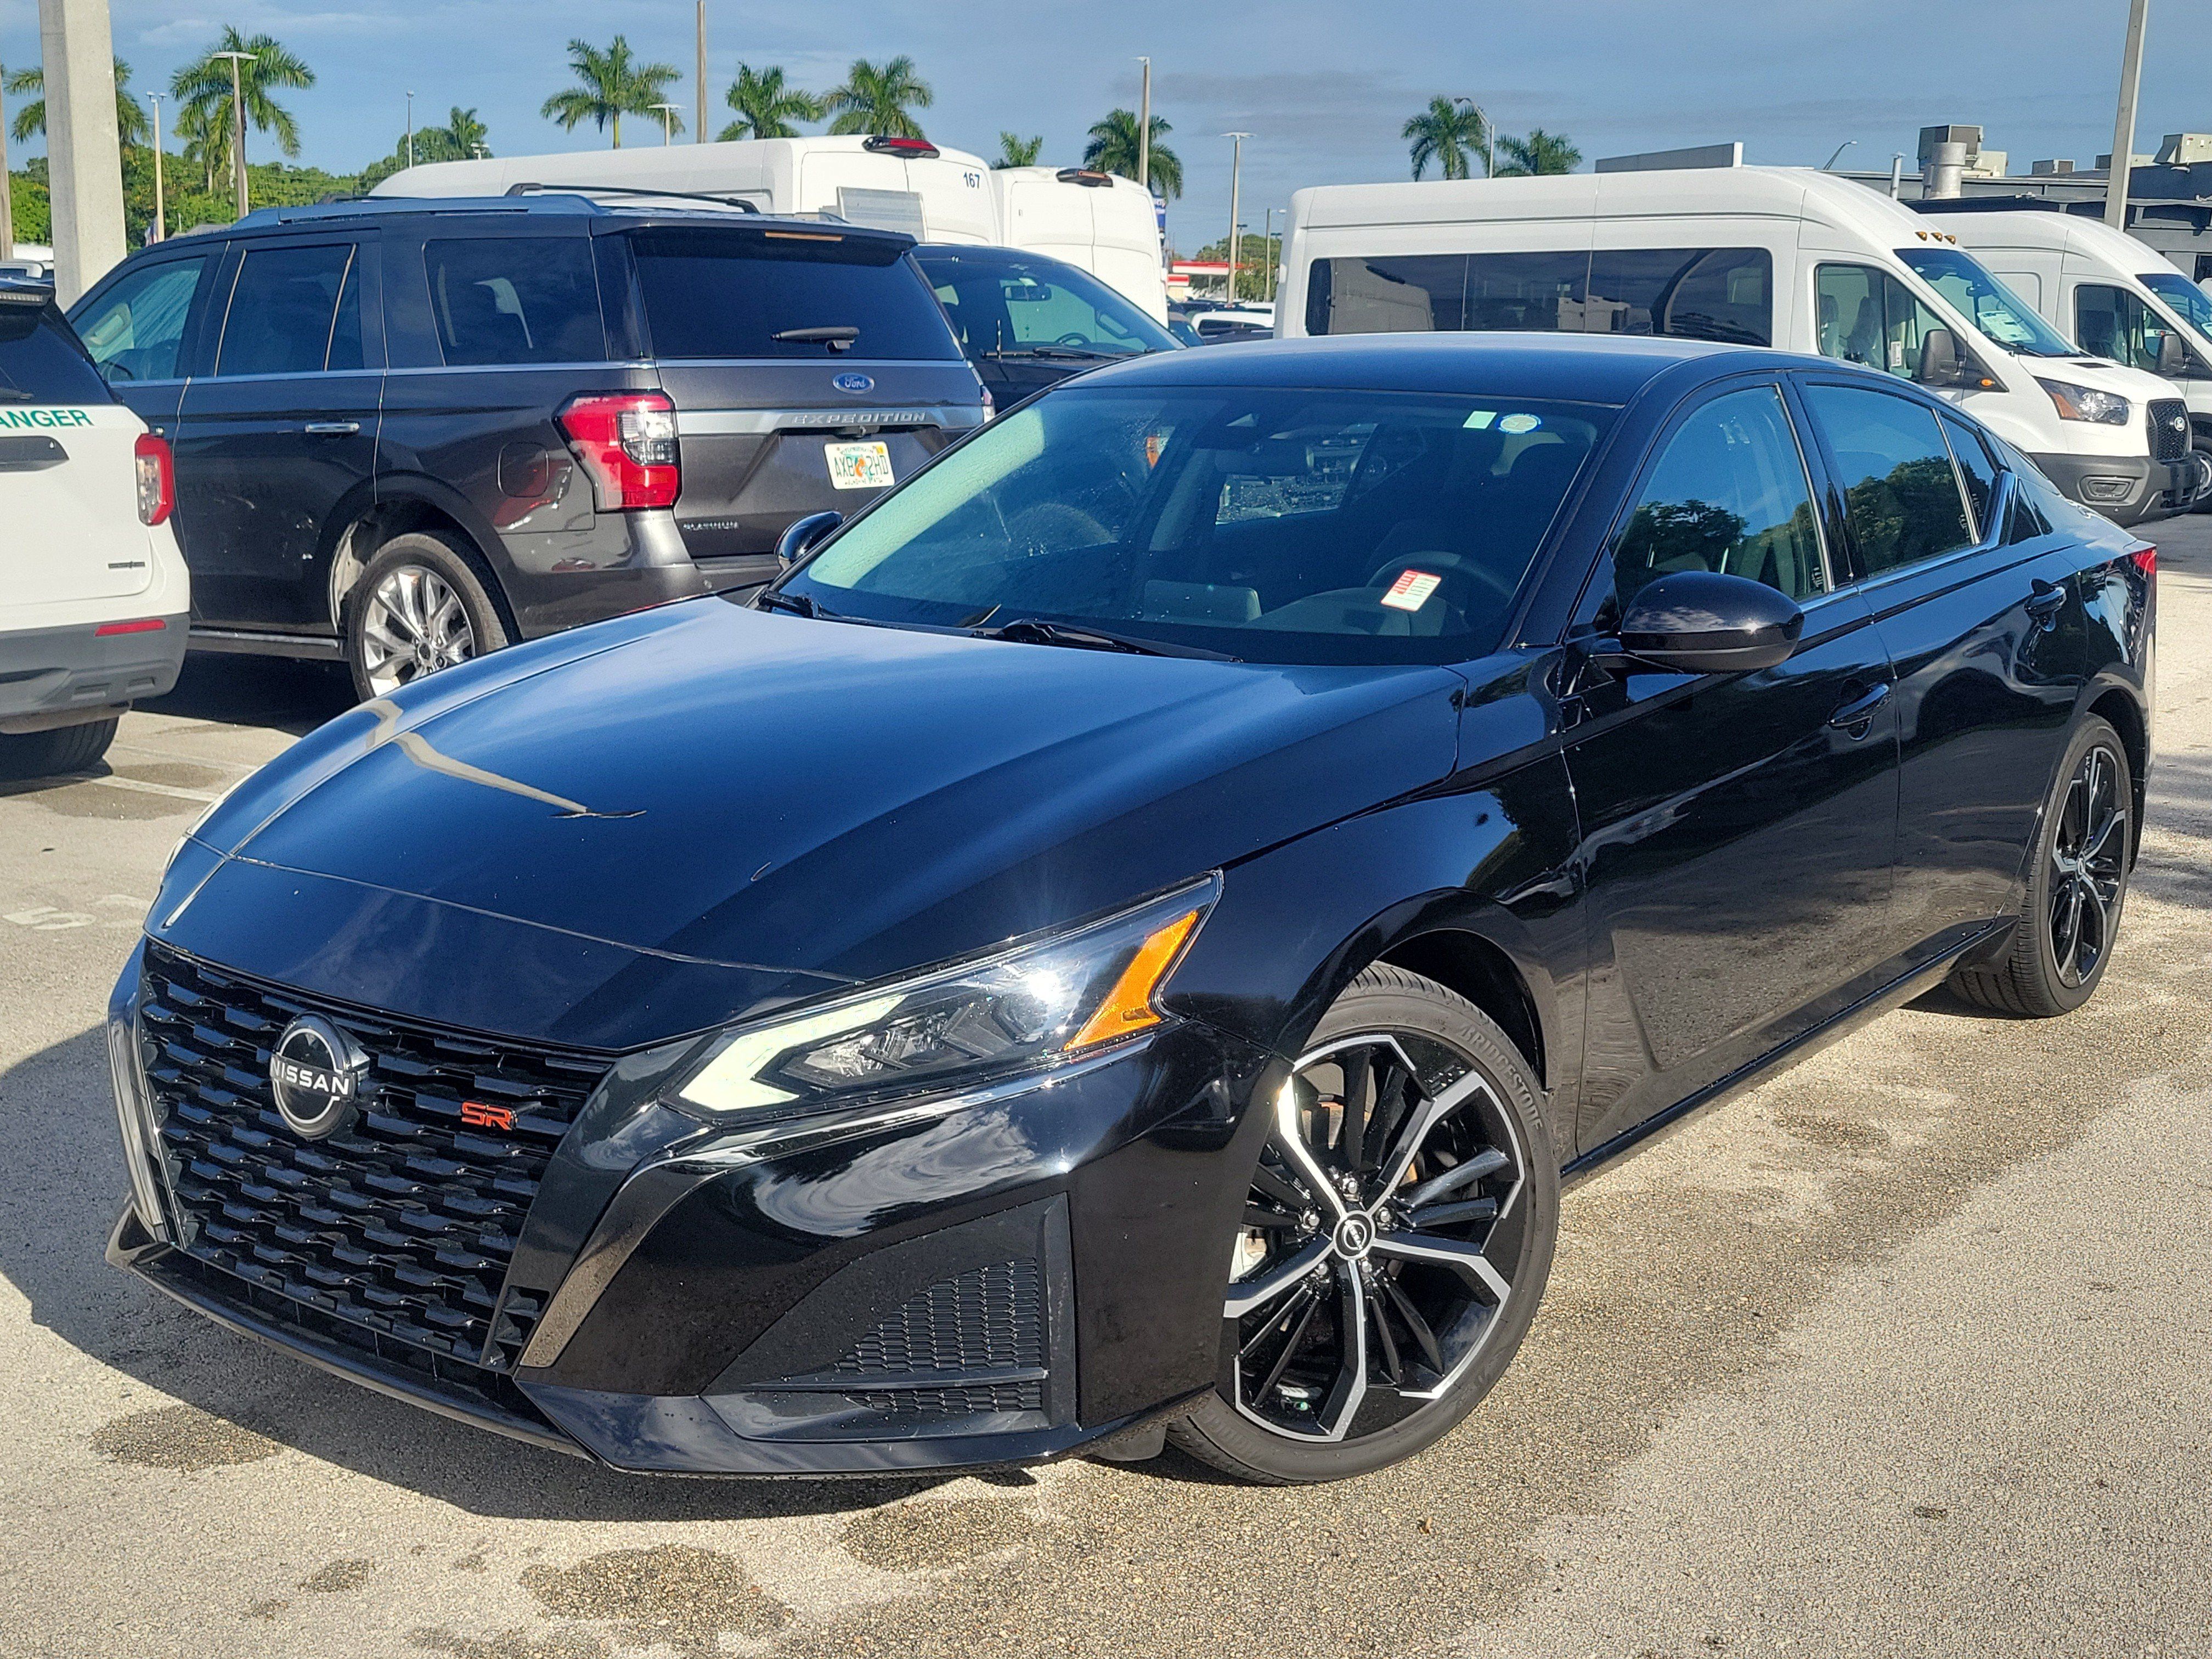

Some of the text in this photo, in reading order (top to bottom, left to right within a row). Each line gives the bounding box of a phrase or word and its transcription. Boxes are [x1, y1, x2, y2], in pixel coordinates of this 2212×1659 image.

[963, 172, 980, 189] 167
[845, 376, 867, 388] Ford
[792, 411, 926, 424] EXPEDITION
[270, 1057, 349, 1095] NISSAN
[461, 1102, 512, 1131] SR
